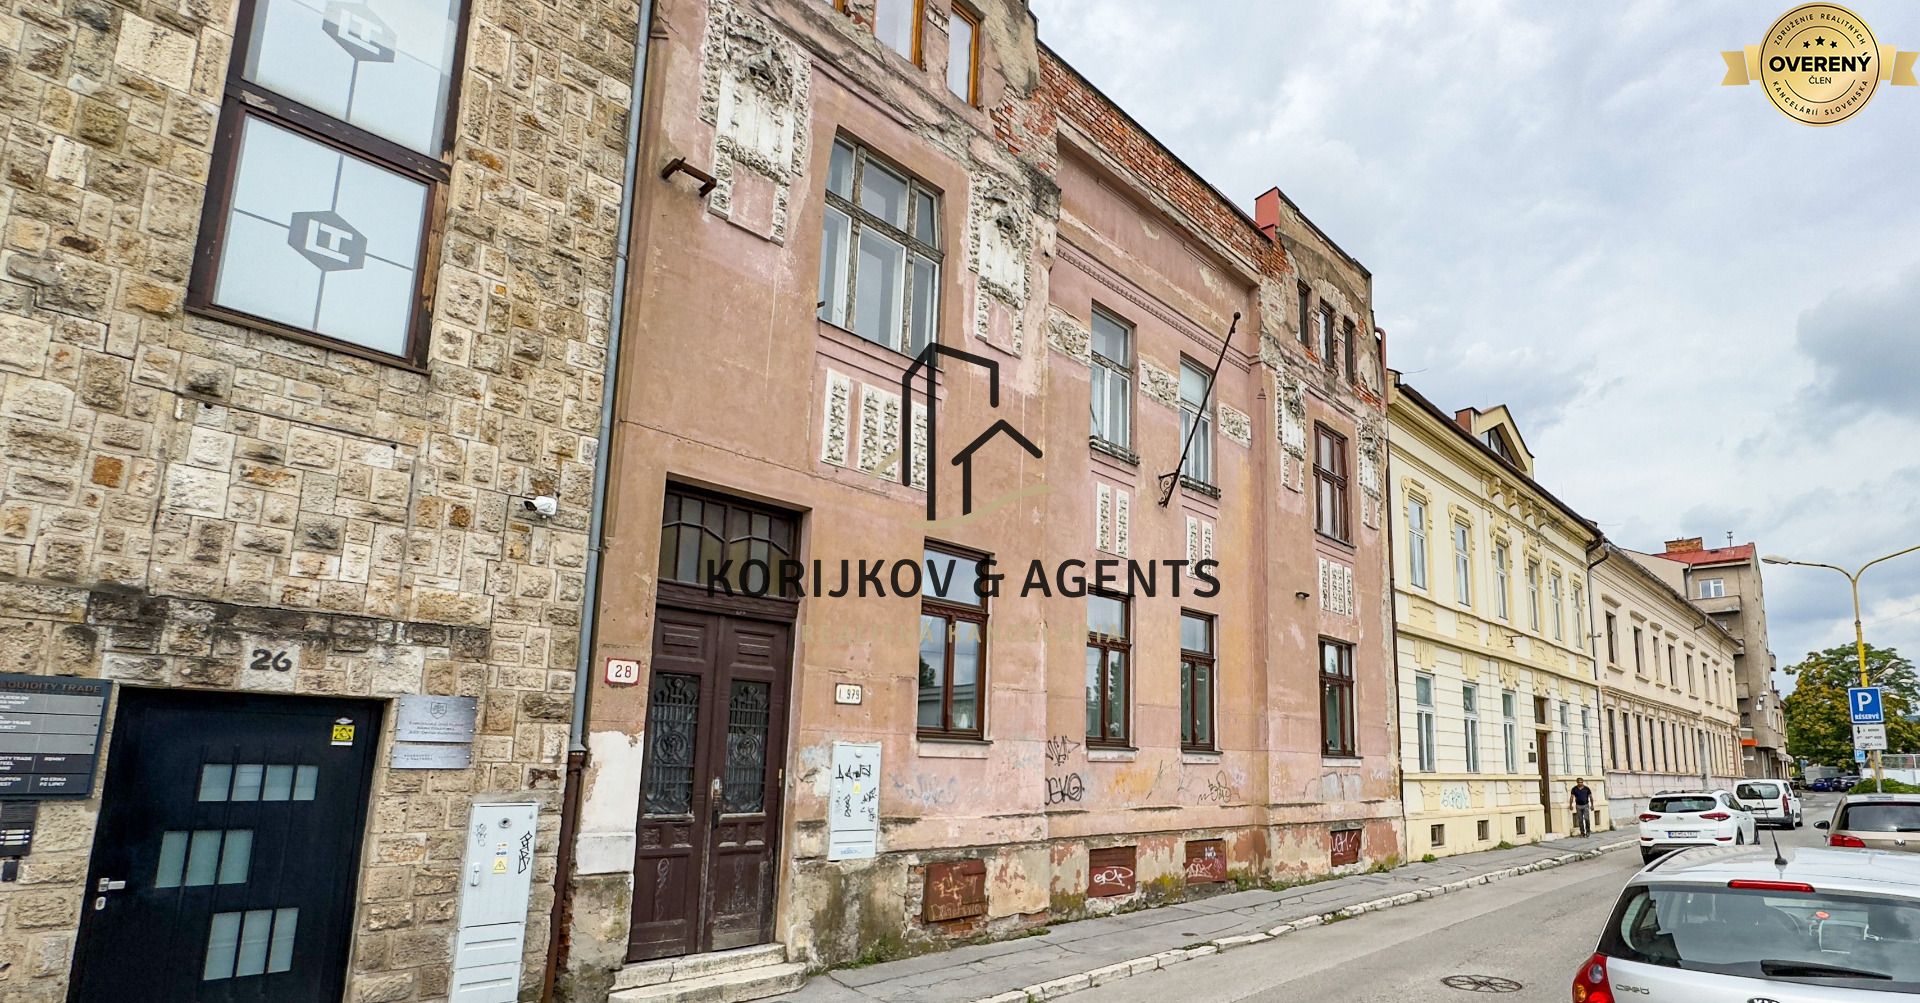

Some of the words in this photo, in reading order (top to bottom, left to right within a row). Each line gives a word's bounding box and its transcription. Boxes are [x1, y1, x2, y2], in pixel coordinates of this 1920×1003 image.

[250, 649, 292, 672] 26
[615, 664, 632, 678] 28
[62, 684, 101, 693] TRADE
[1857, 692, 1872, 711] P
